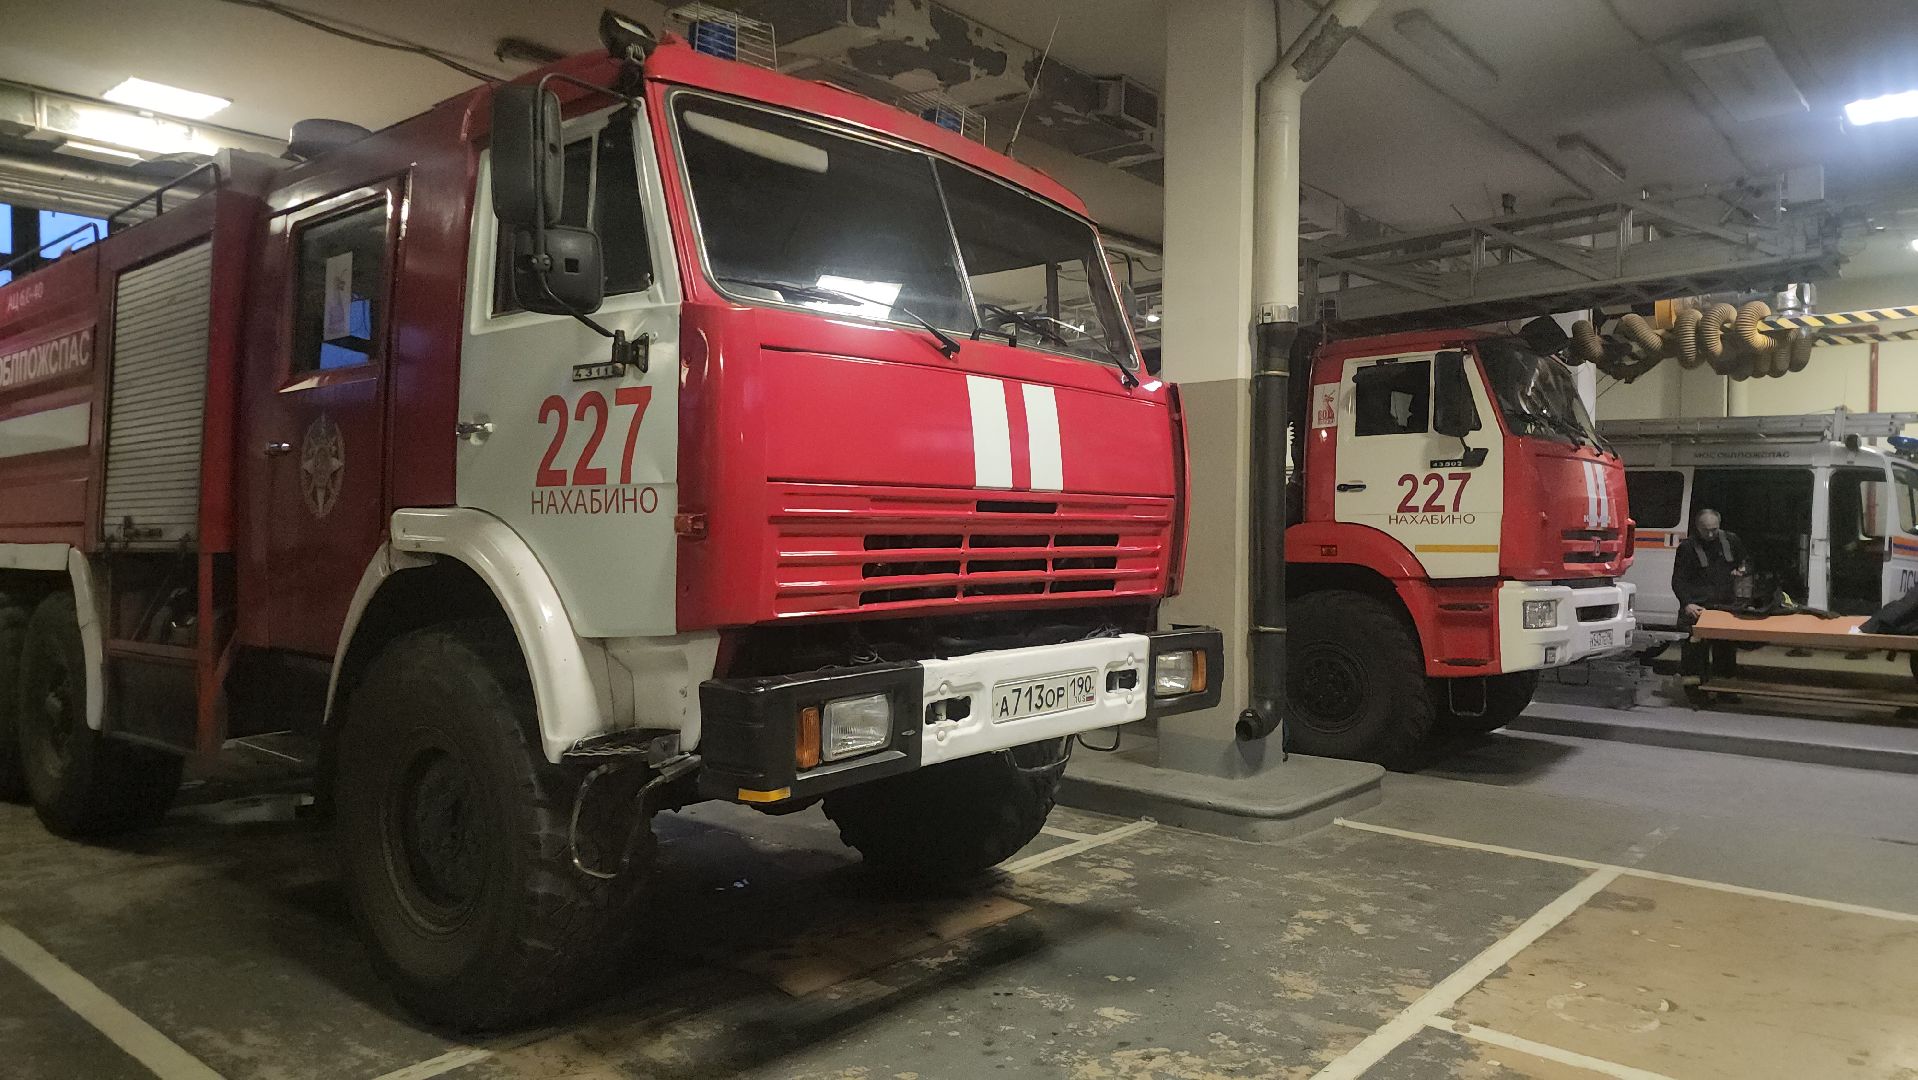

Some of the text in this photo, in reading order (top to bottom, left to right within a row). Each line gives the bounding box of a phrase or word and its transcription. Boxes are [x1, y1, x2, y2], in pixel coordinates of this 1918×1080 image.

[536, 386, 653, 487] 227
[531, 487, 658, 515] НАХАБИНО
[1397, 472, 1472, 513] 227
[1388, 513, 1476, 525] НАХАБИНО
[999, 675, 1092, 718] А713ОР 190
